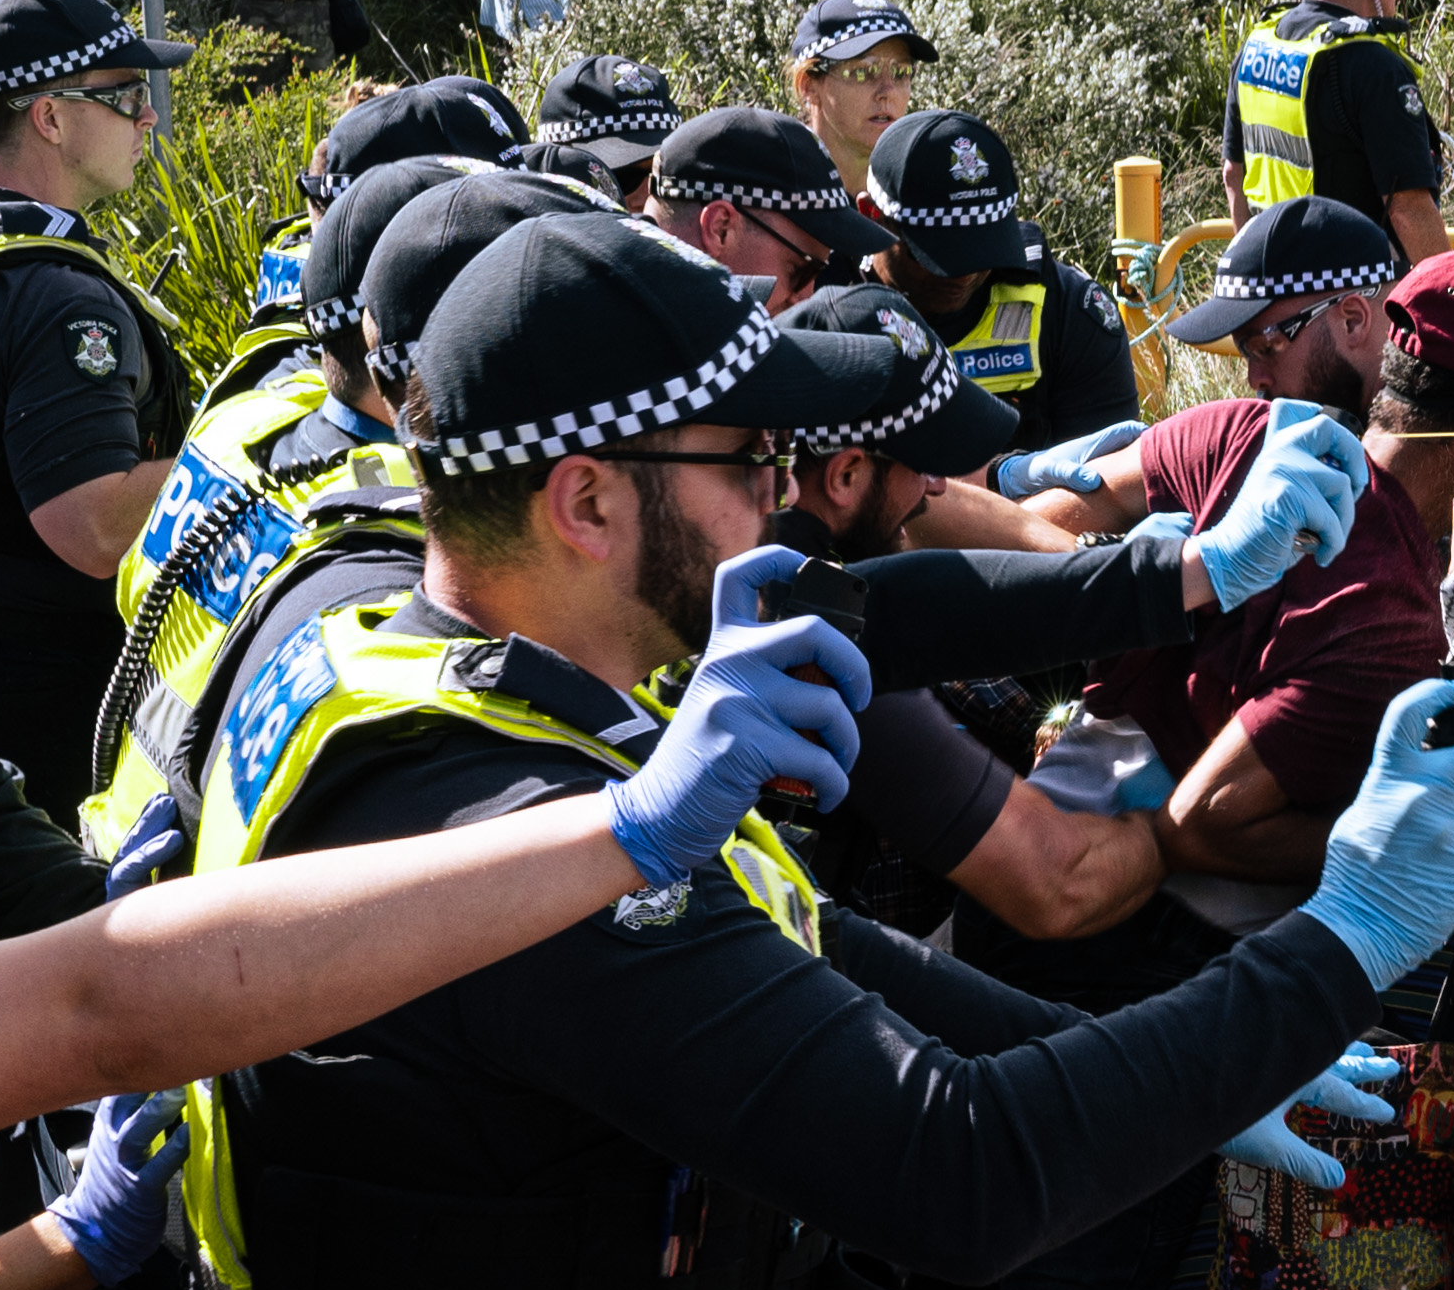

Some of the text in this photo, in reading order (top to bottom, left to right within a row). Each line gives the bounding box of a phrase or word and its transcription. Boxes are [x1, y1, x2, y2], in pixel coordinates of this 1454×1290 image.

[1240, 41, 1303, 89] Police
[948, 189, 979, 201] VICTORIA
[67, 320, 119, 336] VICTORIA POLICE
[963, 351, 1024, 372] Police
